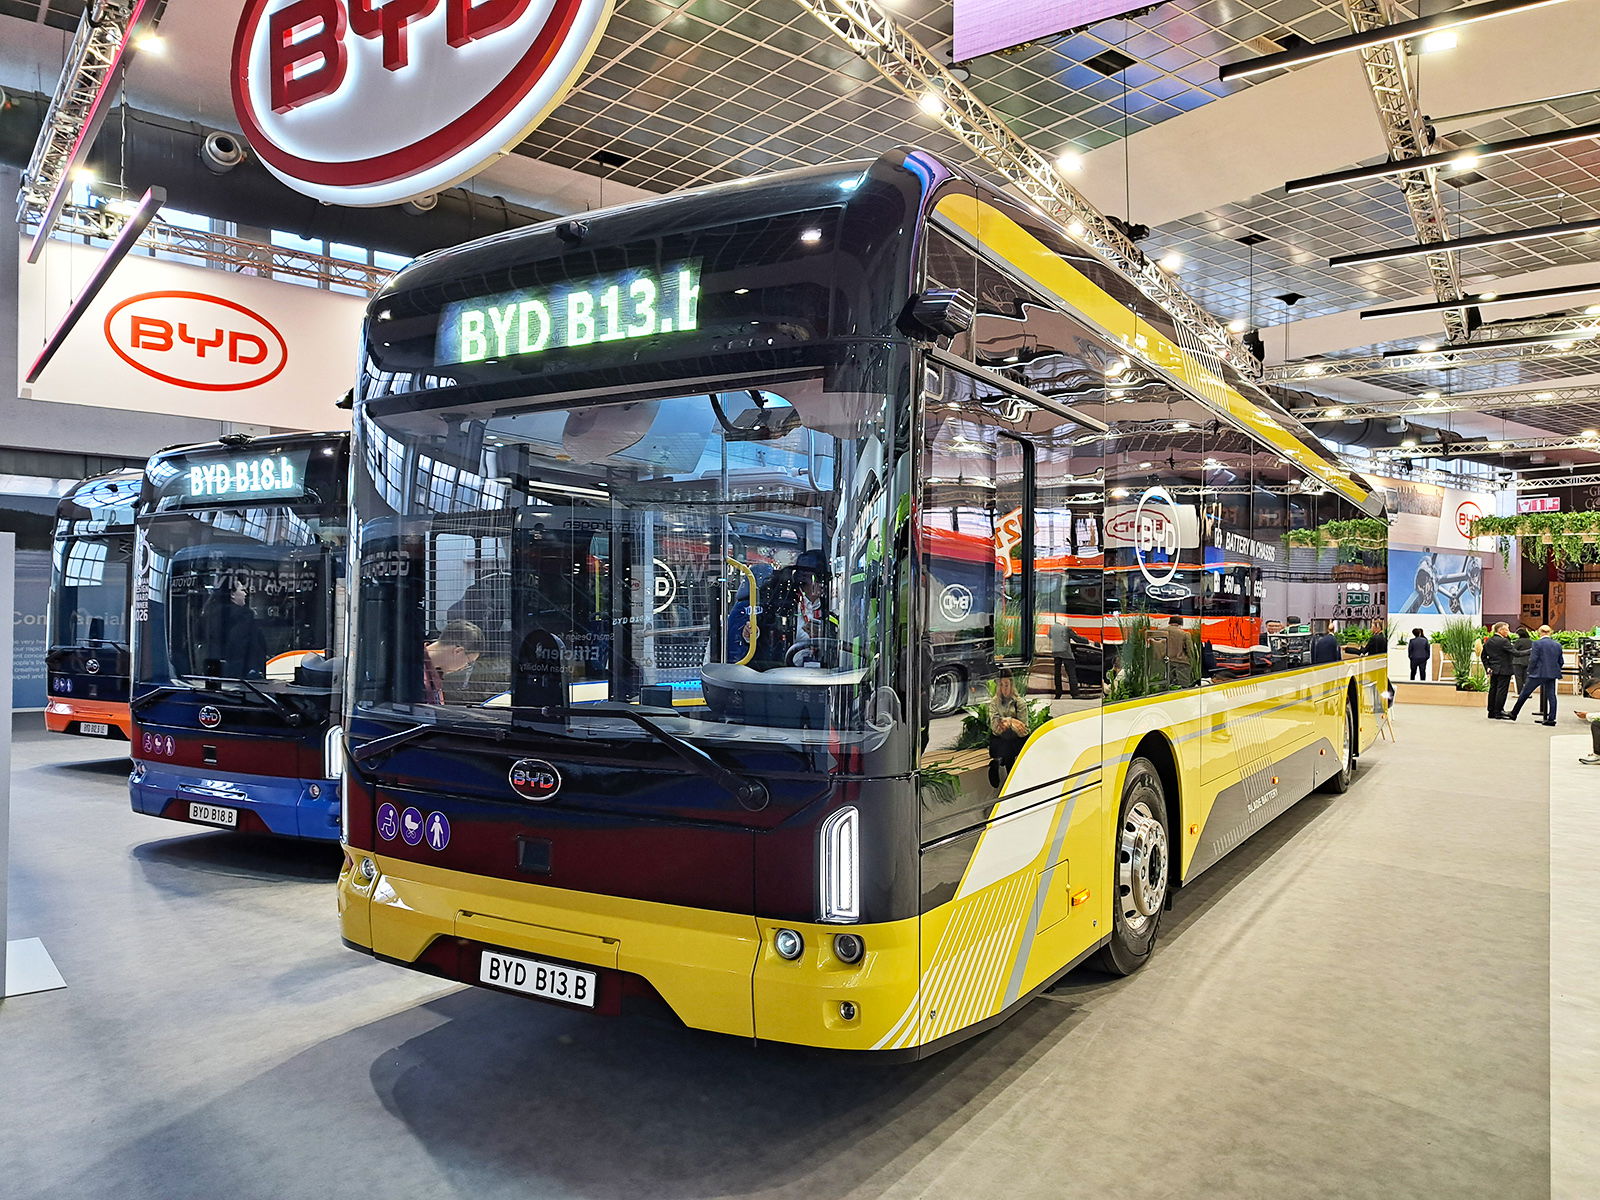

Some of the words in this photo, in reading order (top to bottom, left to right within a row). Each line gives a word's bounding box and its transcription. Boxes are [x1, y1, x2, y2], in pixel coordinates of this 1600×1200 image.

[131, 315, 268, 365] BYD
[461, 299, 550, 363] BYD
[191, 464, 230, 496] BYD
[236, 456, 294, 493] B18.b
[1142, 516, 1176, 556] BYD
[1225, 531, 1250, 556] BATTERY
[1250, 539, 1256, 557] IN
[201, 712, 219, 721] BYD
[514, 769, 554, 788] BYD
[193, 806, 210, 819] BYD
[211, 808, 234, 823] B18.B
[489, 957, 527, 986] BYD
[535, 967, 588, 1000] B13.B
